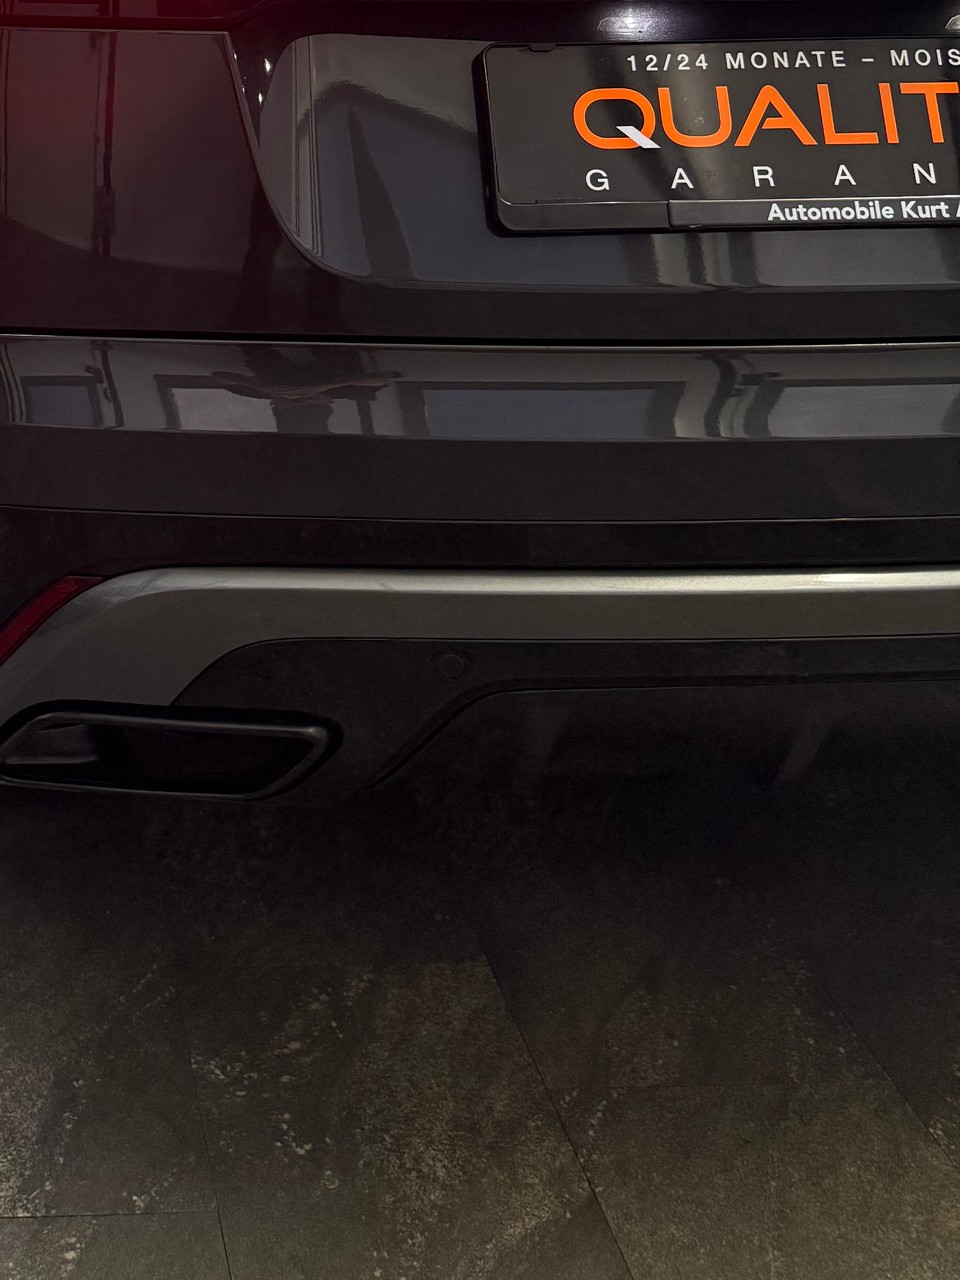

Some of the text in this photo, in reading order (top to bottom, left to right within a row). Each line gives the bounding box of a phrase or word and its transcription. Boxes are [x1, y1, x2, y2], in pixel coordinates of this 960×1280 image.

[626, 52, 709, 72] 12/24
[725, 50, 847, 70] MONATE
[889, 48, 960, 67] MOIS
[767, 200, 895, 221] Automobile
[900, 200, 951, 219] Kurt
